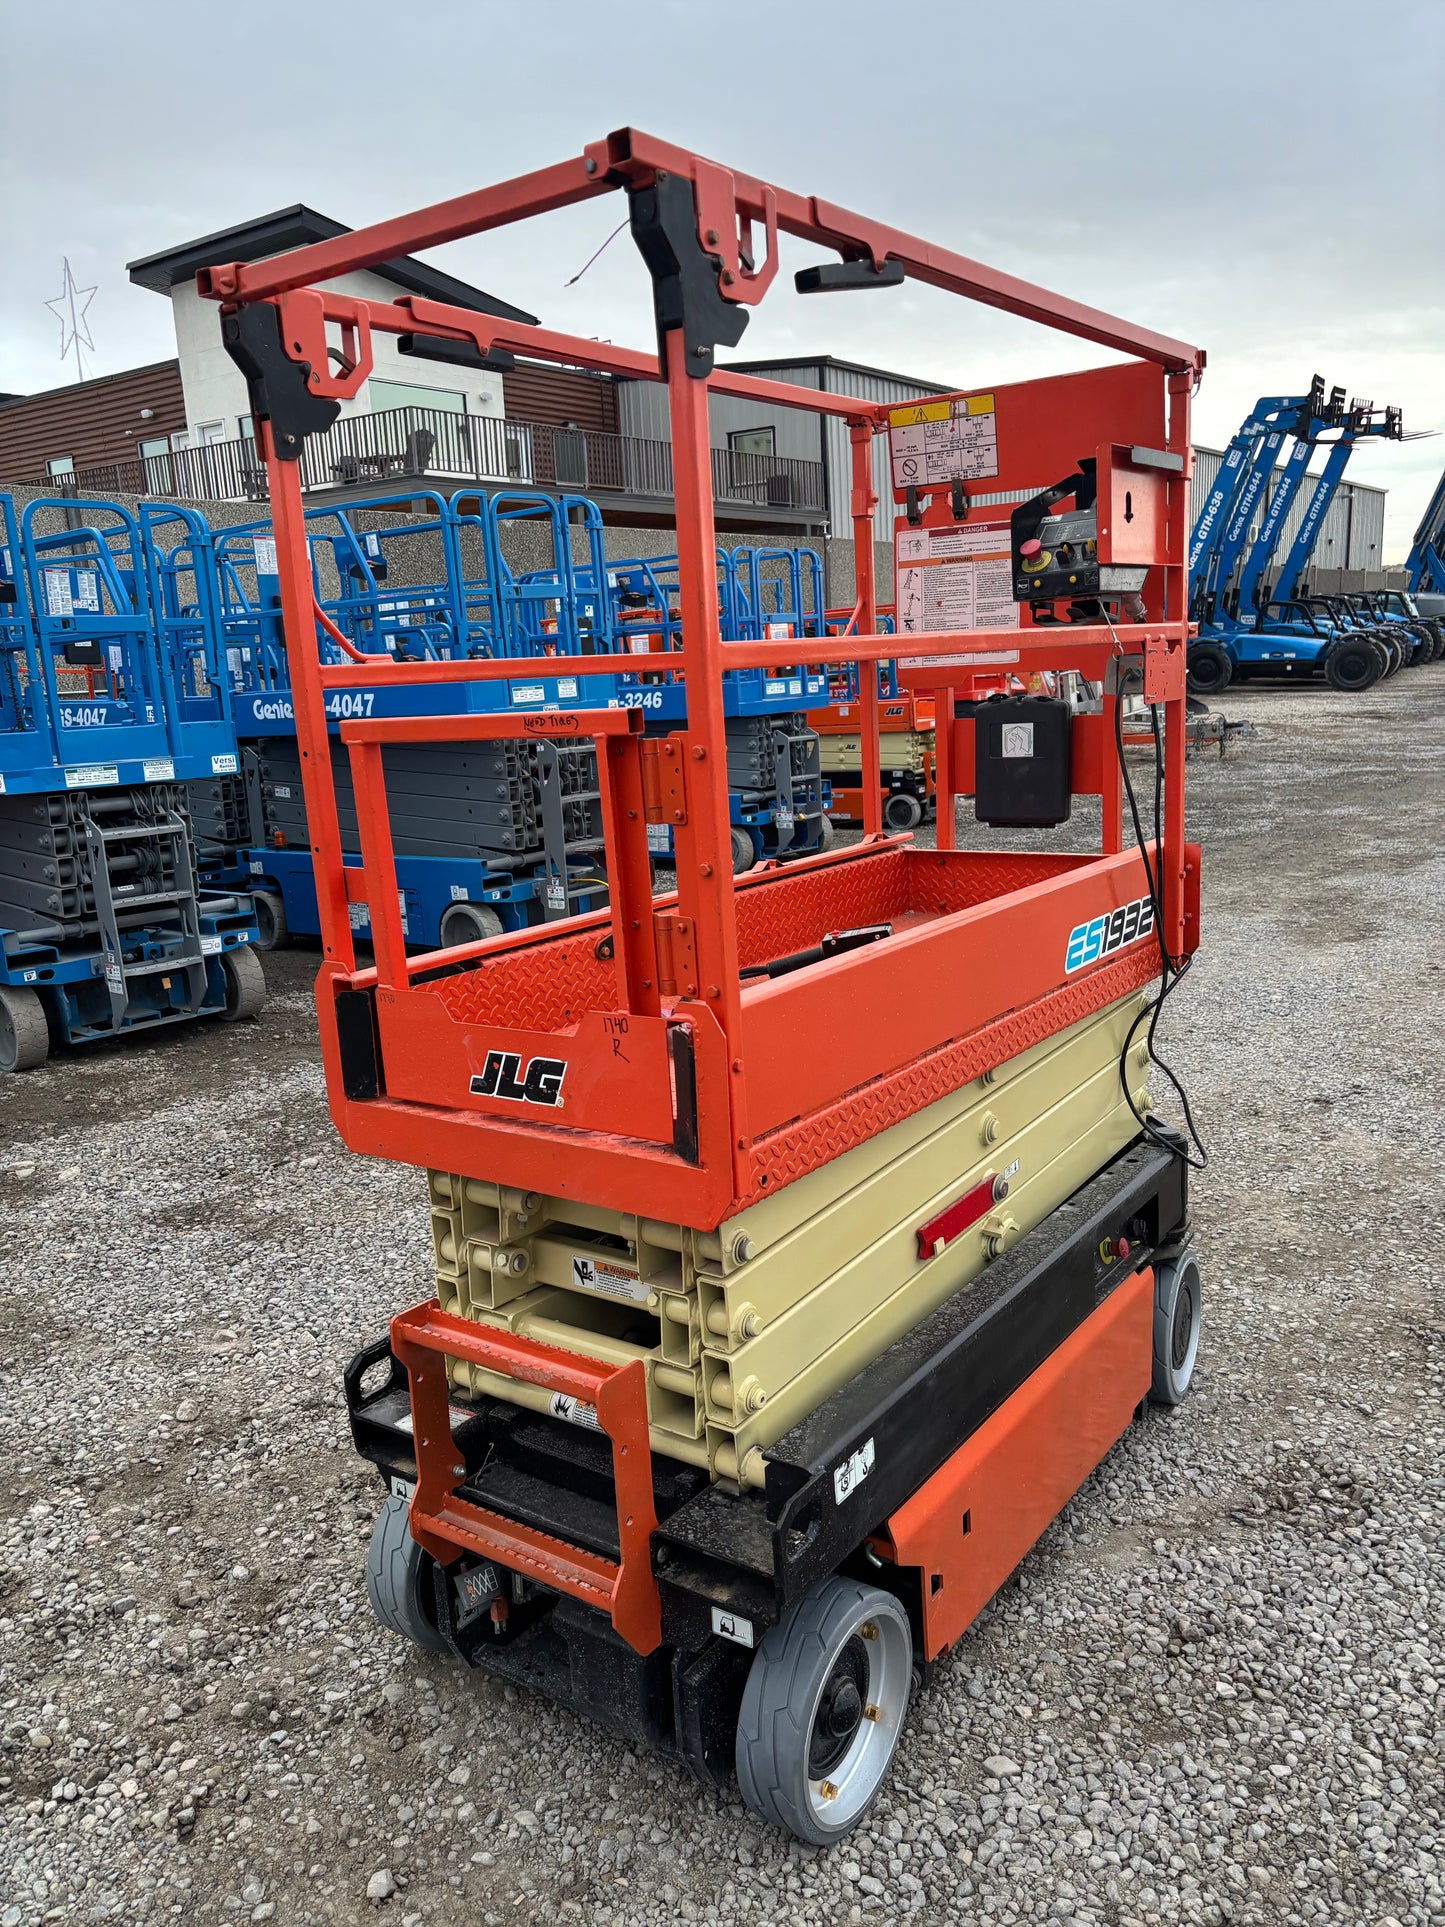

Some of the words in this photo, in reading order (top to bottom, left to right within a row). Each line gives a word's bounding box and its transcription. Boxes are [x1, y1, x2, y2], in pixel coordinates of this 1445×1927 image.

[1240, 471, 1262, 515] GTH-844
[1270, 477, 1291, 517] GTH-844
[1309, 482, 1329, 520] GTH-844
[963, 525, 988, 534] DANGER
[1198, 491, 1224, 540] GTH-636
[252, 699, 294, 720] Genie
[323, 693, 375, 718] -4047
[884, 706, 904, 716] JLG
[213, 755, 235, 765] Versi
[1065, 896, 1155, 974] ES1932
[602, 1016, 629, 1035] 1740
[612, 1038, 631, 1063] R
[469, 1050, 568, 1106] JLG
